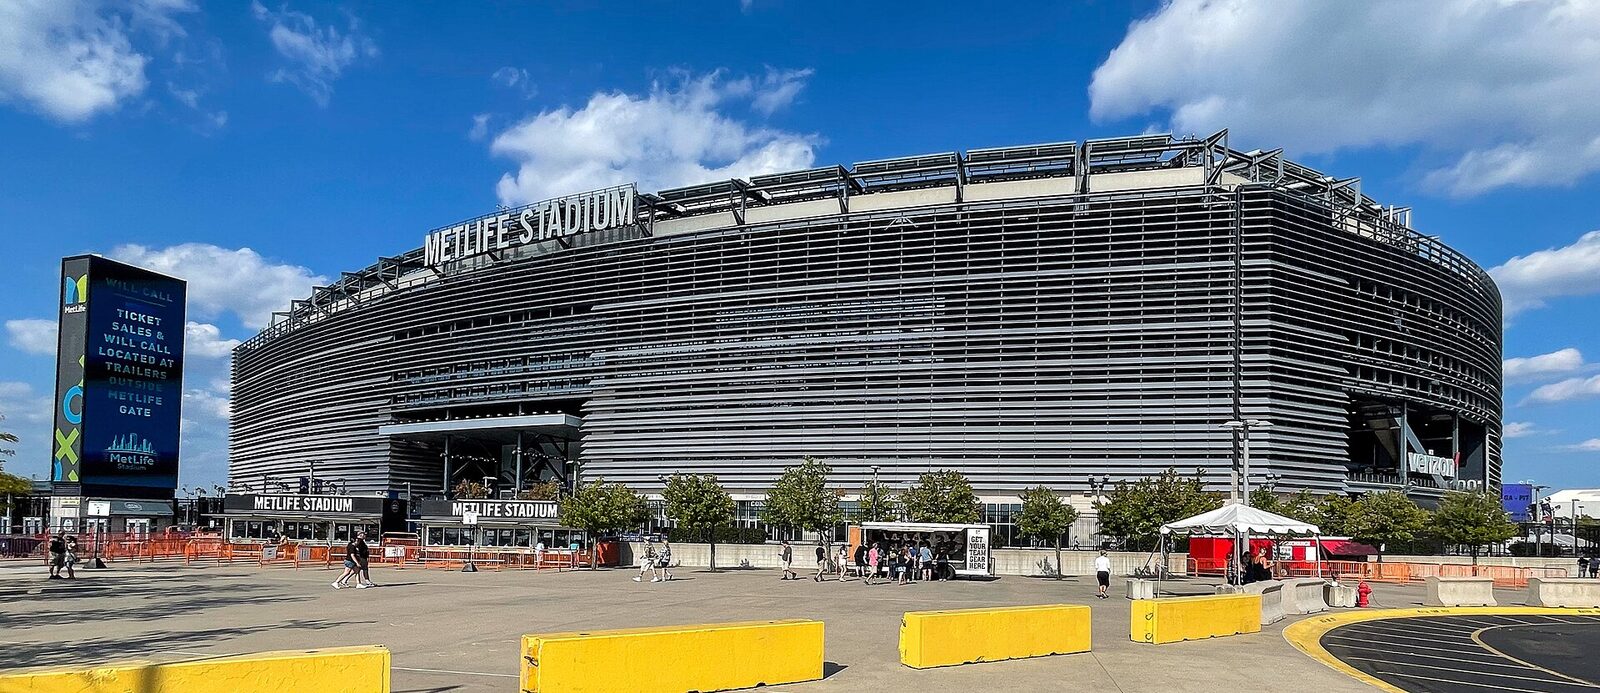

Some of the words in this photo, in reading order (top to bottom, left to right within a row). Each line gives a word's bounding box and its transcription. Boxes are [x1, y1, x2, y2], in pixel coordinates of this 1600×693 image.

[424, 213, 510, 267] METLIFE
[518, 187, 635, 245] STADIUM
[106, 276, 138, 294] WILL
[143, 286, 174, 303] CALL
[64, 304, 87, 314] MetLife
[116, 308, 162, 327] TICKET
[112, 322, 152, 338] SALES
[156, 331, 165, 341] &
[103, 333, 136, 349] WILL
[140, 341, 171, 355] CALL
[98, 346, 155, 365] LOCATED
[159, 358, 175, 369] AT
[105, 361, 167, 381] TRAILERS
[108, 376, 163, 393] OUTSIDE
[108, 391, 163, 406] METLIFE
[119, 405, 152, 418] GATE
[109, 453, 155, 466] MetLife
[1407, 449, 1455, 478] verizon
[254, 496, 301, 511] METLIFE
[303, 497, 353, 512] STADIUM
[452, 502, 502, 517] METLIFE
[504, 503, 558, 518] STADIUM
